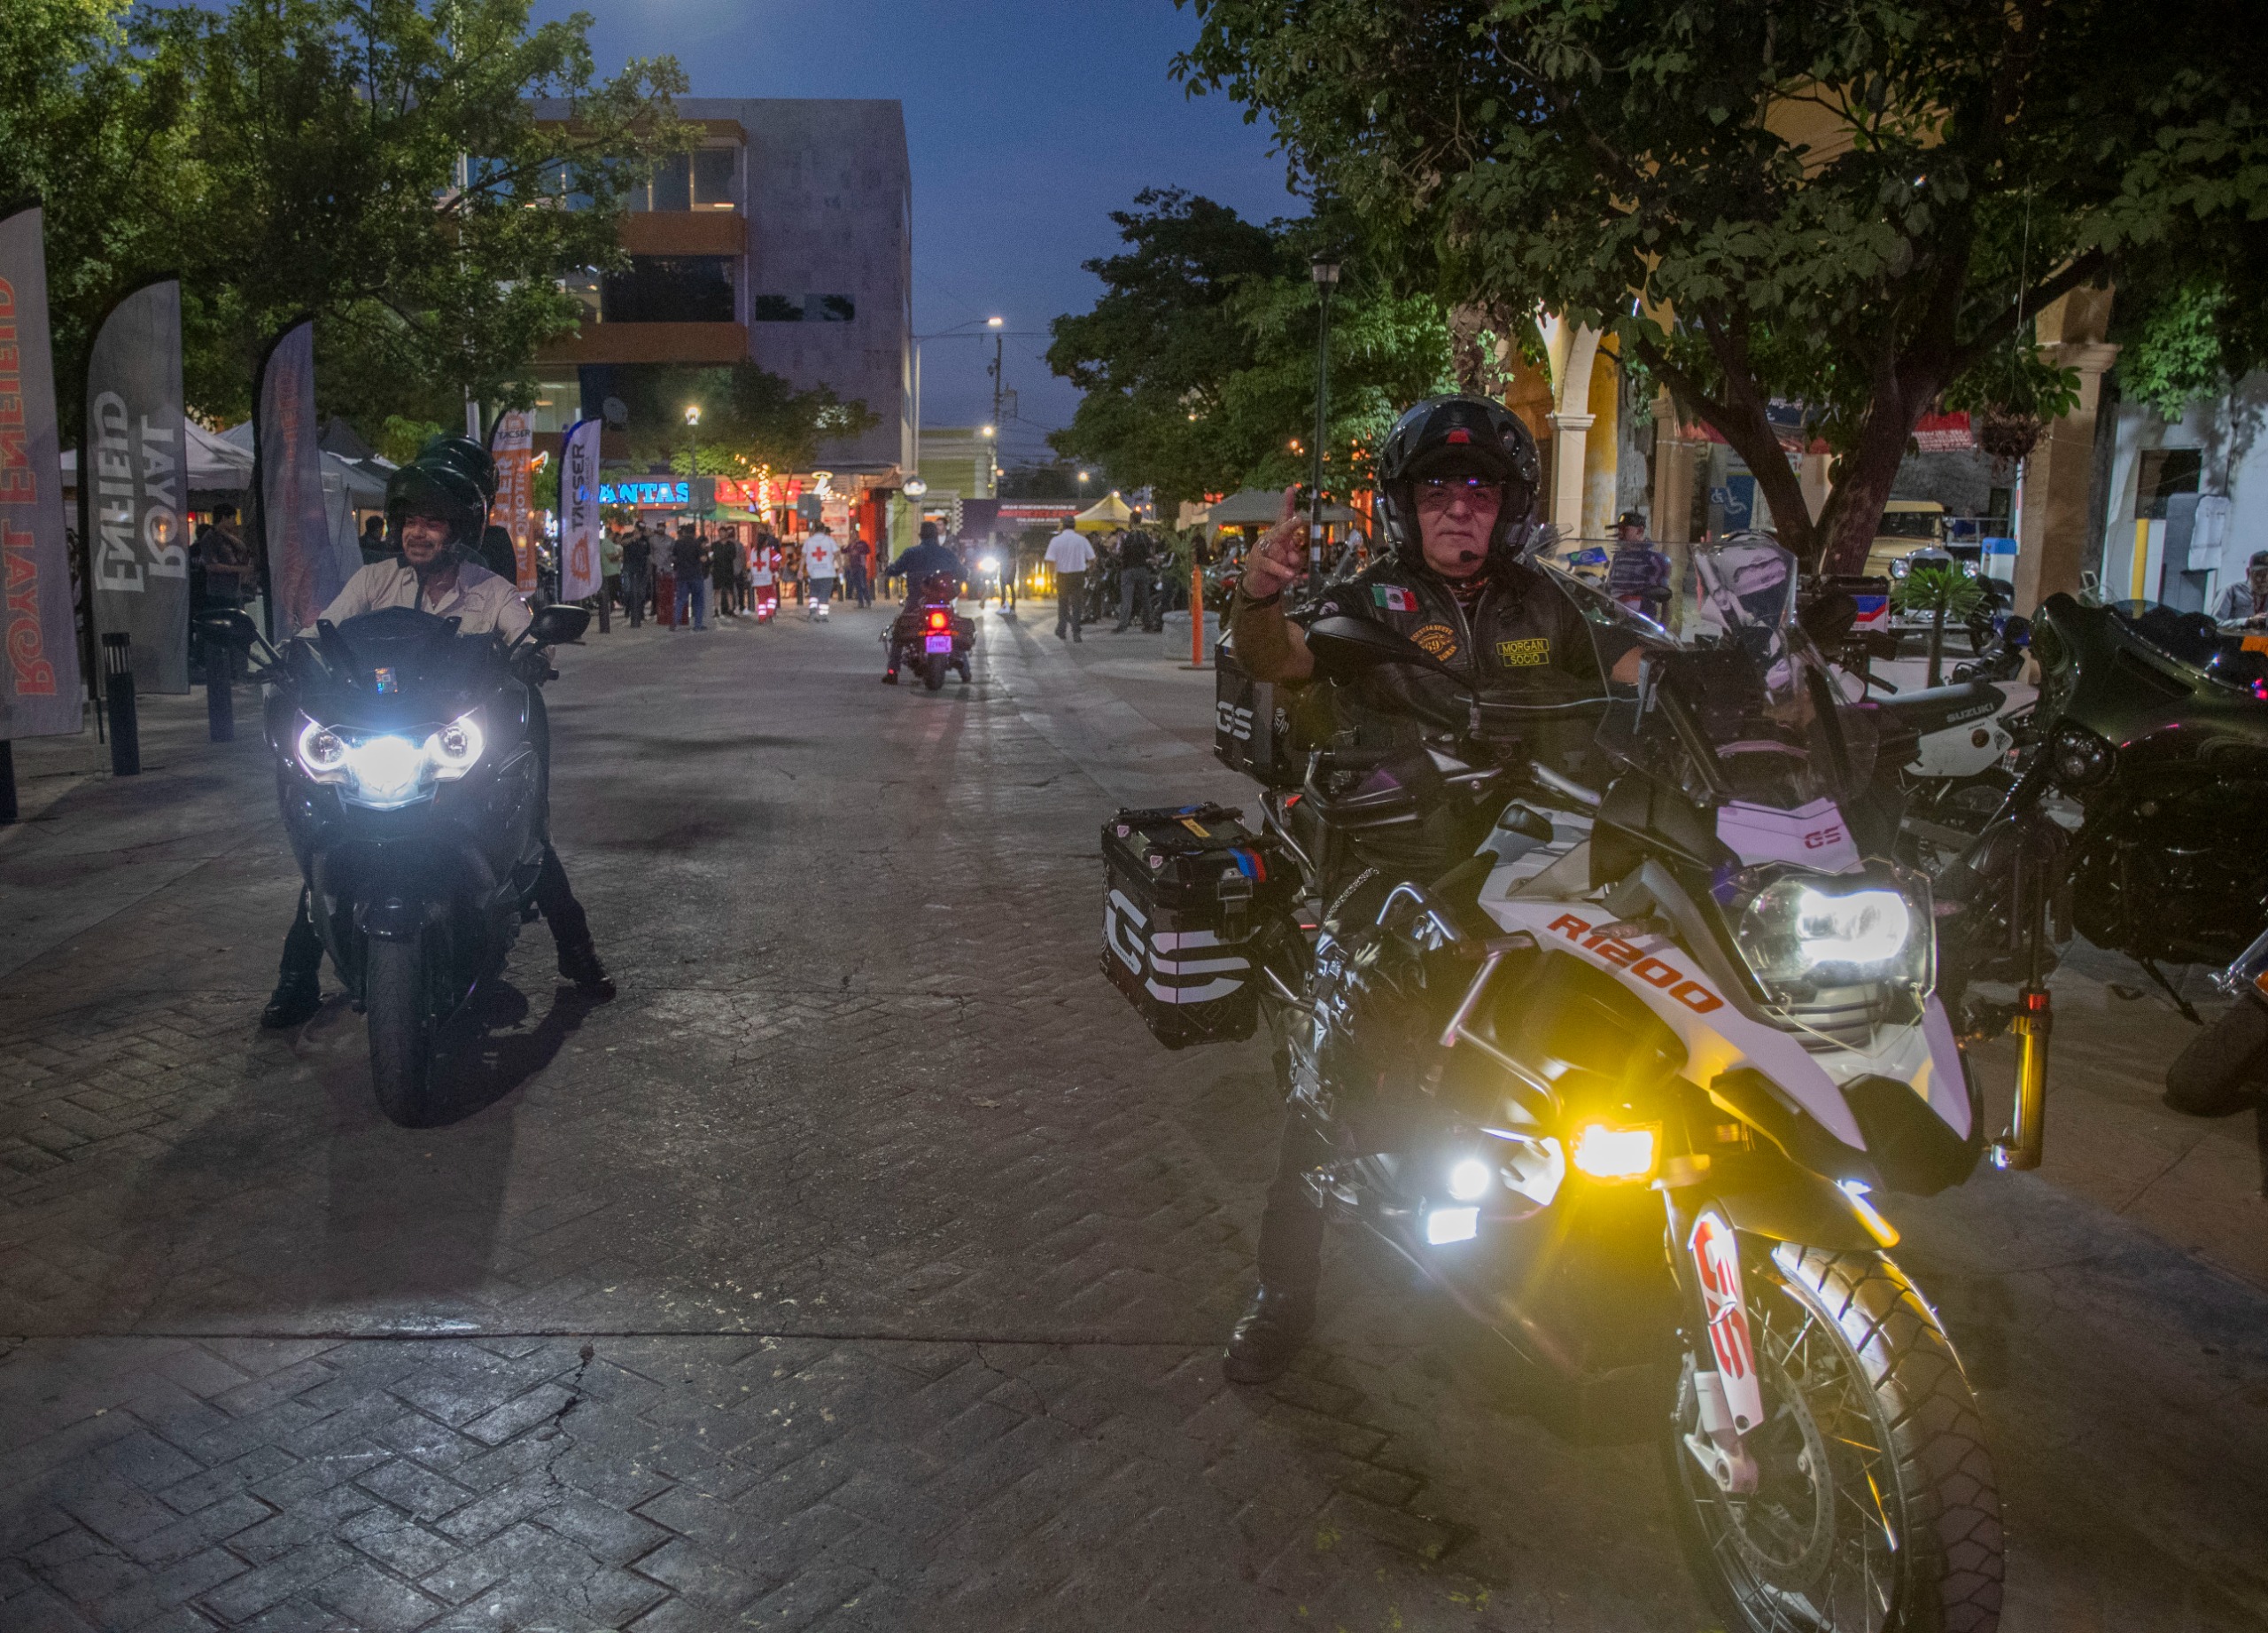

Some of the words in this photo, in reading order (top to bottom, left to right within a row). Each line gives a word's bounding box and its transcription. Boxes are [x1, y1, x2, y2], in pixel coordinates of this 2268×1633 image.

[496, 455, 513, 537] LLER
[1502, 640, 1544, 654] MORGAN
[1510, 654, 1540, 665] SOCIO
[1216, 700, 1254, 740] GS
[1946, 703, 1994, 723] SUZUKI
[1804, 826, 1842, 849] GS
[1106, 889, 1251, 1004] GS
[1547, 913, 1724, 1015] R1200
